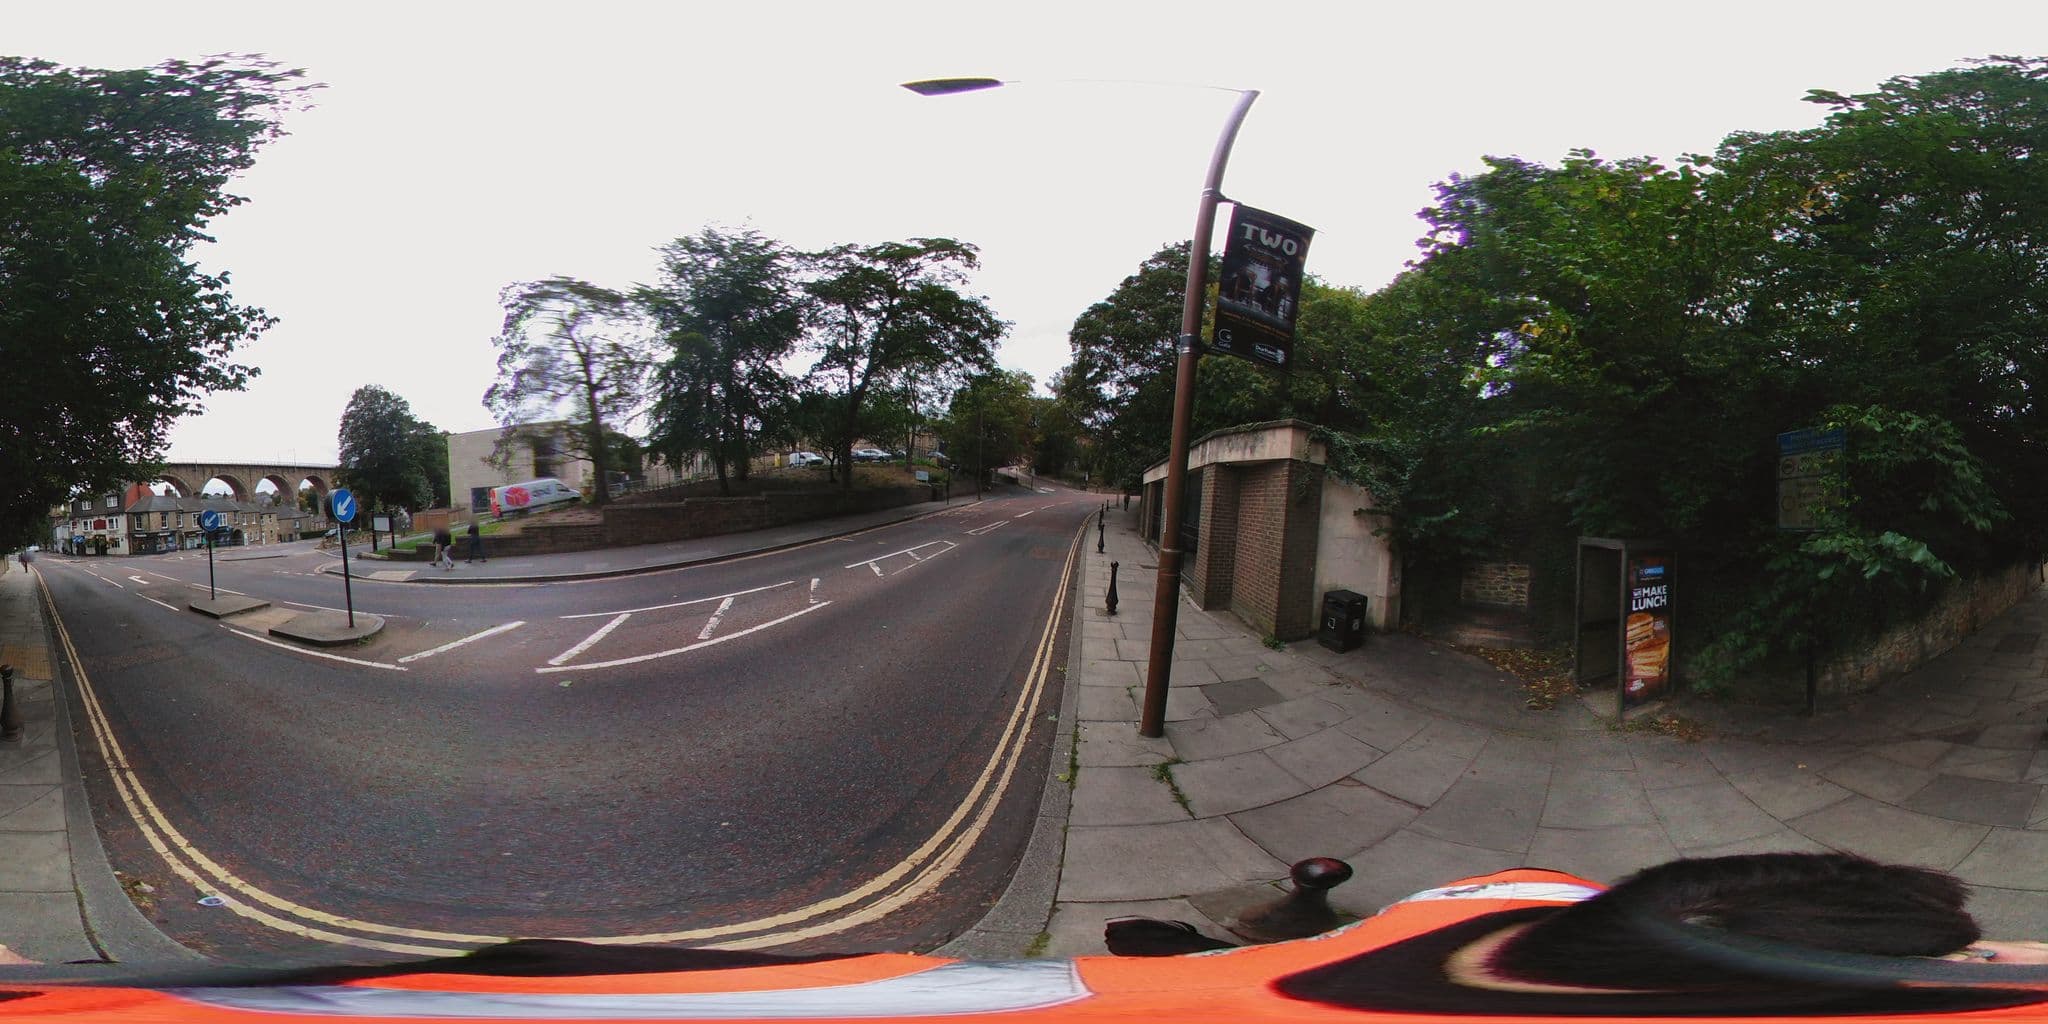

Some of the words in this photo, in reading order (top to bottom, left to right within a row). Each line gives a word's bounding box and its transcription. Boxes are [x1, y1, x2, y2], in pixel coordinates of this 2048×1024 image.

[1241, 223, 1298, 256] TWO
[1643, 584, 1667, 597] MAKE
[1632, 595, 1667, 611] LUNCH
